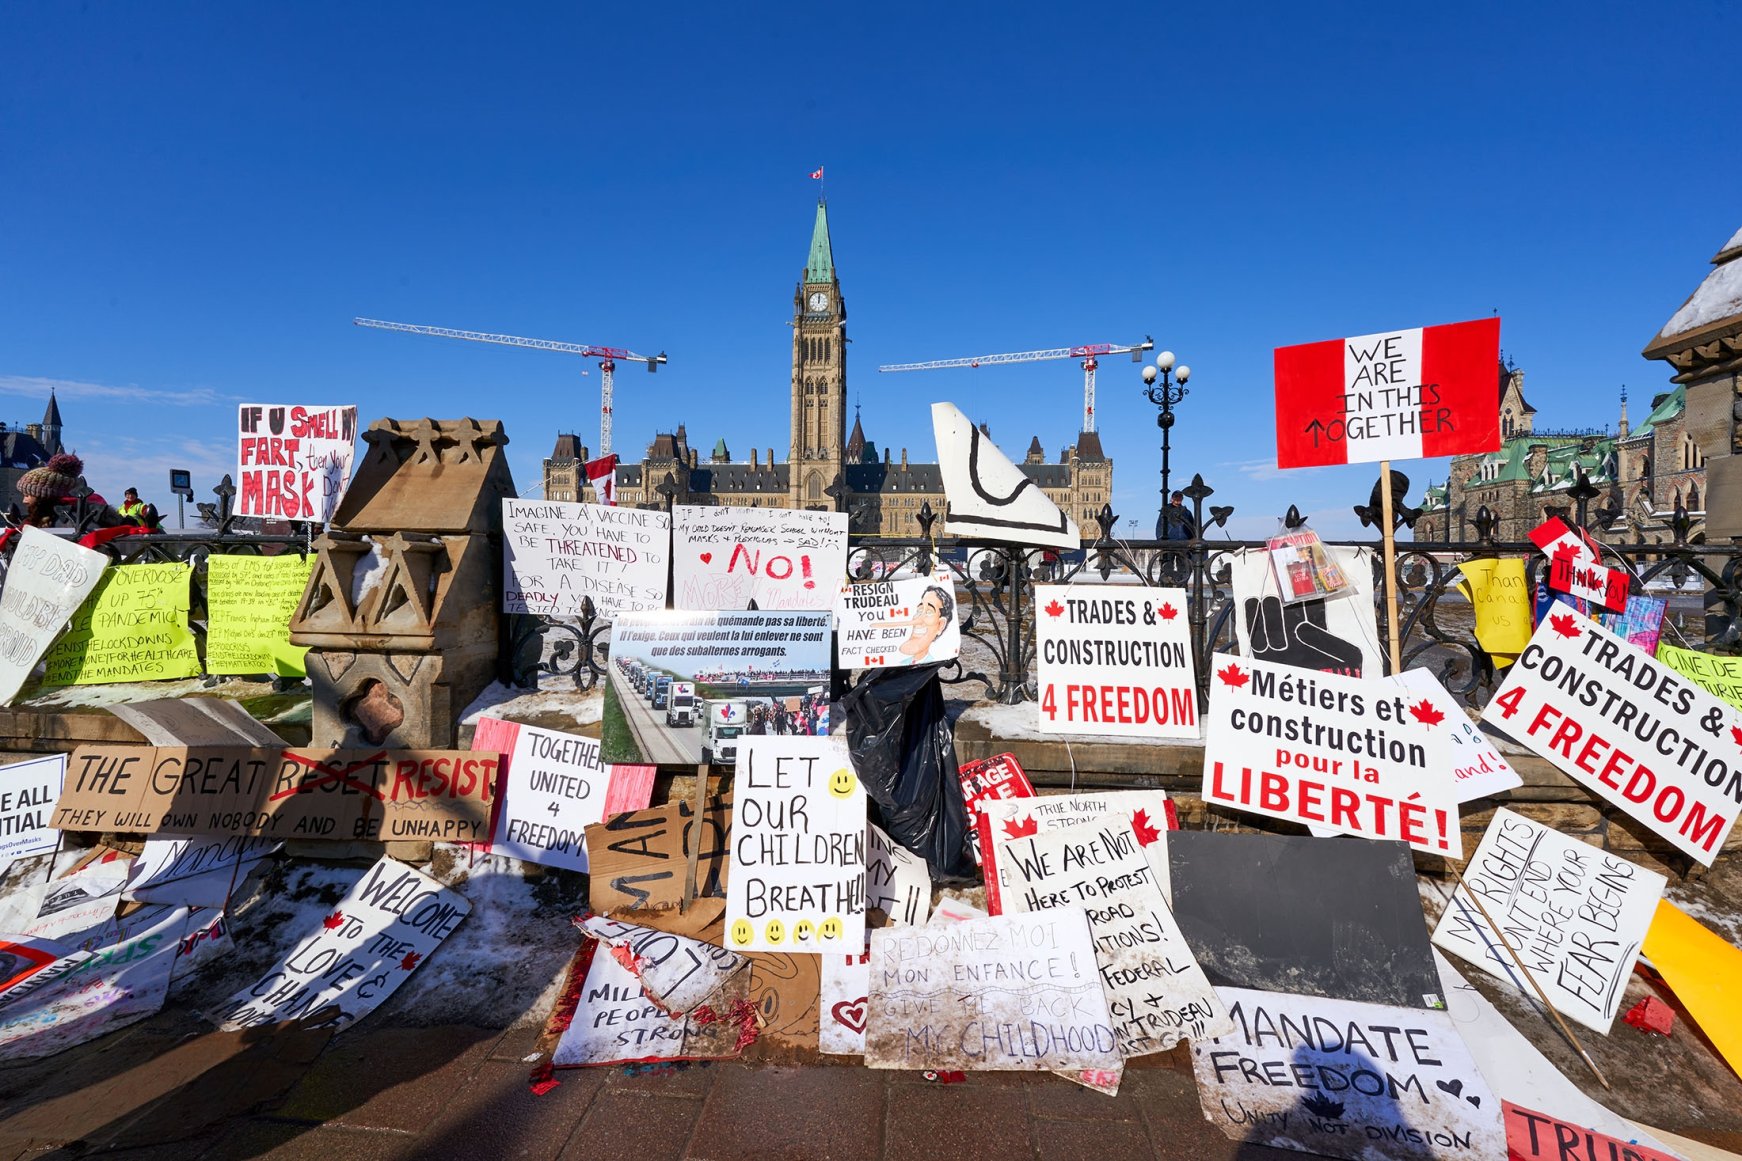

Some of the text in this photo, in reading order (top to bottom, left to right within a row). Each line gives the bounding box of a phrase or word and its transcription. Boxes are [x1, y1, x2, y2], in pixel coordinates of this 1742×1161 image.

[1349, 336, 1402, 363] WE
[1351, 358, 1406, 388] ARE
[1336, 383, 1441, 414] IN THIS
[241, 407, 262, 433] IF
[269, 407, 285, 436] U
[290, 406, 338, 439] SMELL
[240, 470, 315, 518] MASK
[561, 523, 588, 539] YOU
[596, 527, 629, 543] HAVE
[635, 532, 650, 544] TO
[596, 509, 670, 530] VACCINE SO
[519, 535, 660, 564] BE THREATENED TO
[546, 557, 583, 571] TAKE
[727, 543, 816, 590] NO!
[40, 554, 89, 588] DAD
[512, 571, 663, 600] FOR A DISEASE SO
[110, 594, 129, 607] UP
[601, 595, 644, 612] HAVE TO
[844, 593, 899, 609] TRUDEAU
[853, 582, 894, 596] RESIGN
[717, 615, 764, 627] quémande
[765, 618, 781, 628] pas
[783, 618, 794, 626] sa
[795, 616, 828, 627] liberté.
[858, 611, 885, 621] YOU
[1067, 599, 1157, 625] TRADES &
[626, 630, 657, 642] l'exige.
[658, 630, 680, 641] Ceux
[680, 630, 696, 642] qui
[696, 630, 730, 641] veulent
[730, 630, 740, 641] la
[741, 630, 754, 641] lui
[754, 630, 789, 641] enlever
[789, 632, 802, 641] ne
[802, 631, 824, 642] sont
[651, 645, 787, 657] que des subalternes arrogants.
[841, 645, 897, 655] FACT CHECKED
[847, 628, 906, 640] HAVE BEEN
[1043, 638, 1186, 668] CONSTRUCTION
[1251, 669, 1406, 725] Métiers et
[1579, 629, 1727, 738] TRADES &
[1042, 683, 1195, 727] 4 FREEDOM
[1231, 708, 1427, 768] construction
[1520, 644, 1742, 805] CONSTRUCTION
[75, 755, 498, 802] THE GREAT RESET RESIST
[748, 748, 820, 788] LET
[1275, 748, 1380, 784] pour la
[1495, 685, 1727, 853] 4 FREEDOM
[16, 785, 53, 810] ALL
[529, 769, 591, 800] UNITED
[58, 808, 107, 826] THEY
[114, 812, 152, 828] WILL
[161, 812, 198, 829] OWN
[209, 811, 284, 832] NOBODY
[293, 815, 336, 835] AND
[352, 818, 380, 837] BE
[391, 819, 482, 838] UNHAPPY
[547, 801, 560, 817] 4
[742, 795, 808, 834] OUR
[1035, 798, 1107, 816] TRUE NORTH
[1211, 761, 1450, 851] LIBERTÉ!
[506, 819, 585, 857] FREEDOM
[737, 829, 866, 867] CHILDREN
[1005, 828, 1136, 882] WE ARE NOT
[1025, 865, 1150, 912] HERE TO PROTEST
[1446, 818, 1534, 944] MY RIGHTS
[1520, 861, 1552, 903] END
[359, 862, 466, 940] WELCOME
[1523, 848, 1591, 974] WHERE YOUR
[337, 914, 415, 960] TO THE
[883, 931, 1000, 967] REDONNEZ
[1009, 921, 1058, 950] MOI
[1556, 856, 1636, 1012] FEAR BEGINS
[285, 936, 365, 991] LOVE
[884, 968, 929, 987] MON
[884, 995, 1094, 1019] GIVE ME BACK
[906, 1020, 1115, 1061] MY CHILDHOOD
[1213, 1001, 1442, 1067] MANDATE
[1210, 1051, 1431, 1105] FREEDOM
[1220, 1099, 1472, 1149] UNITY NOT DIVISION
